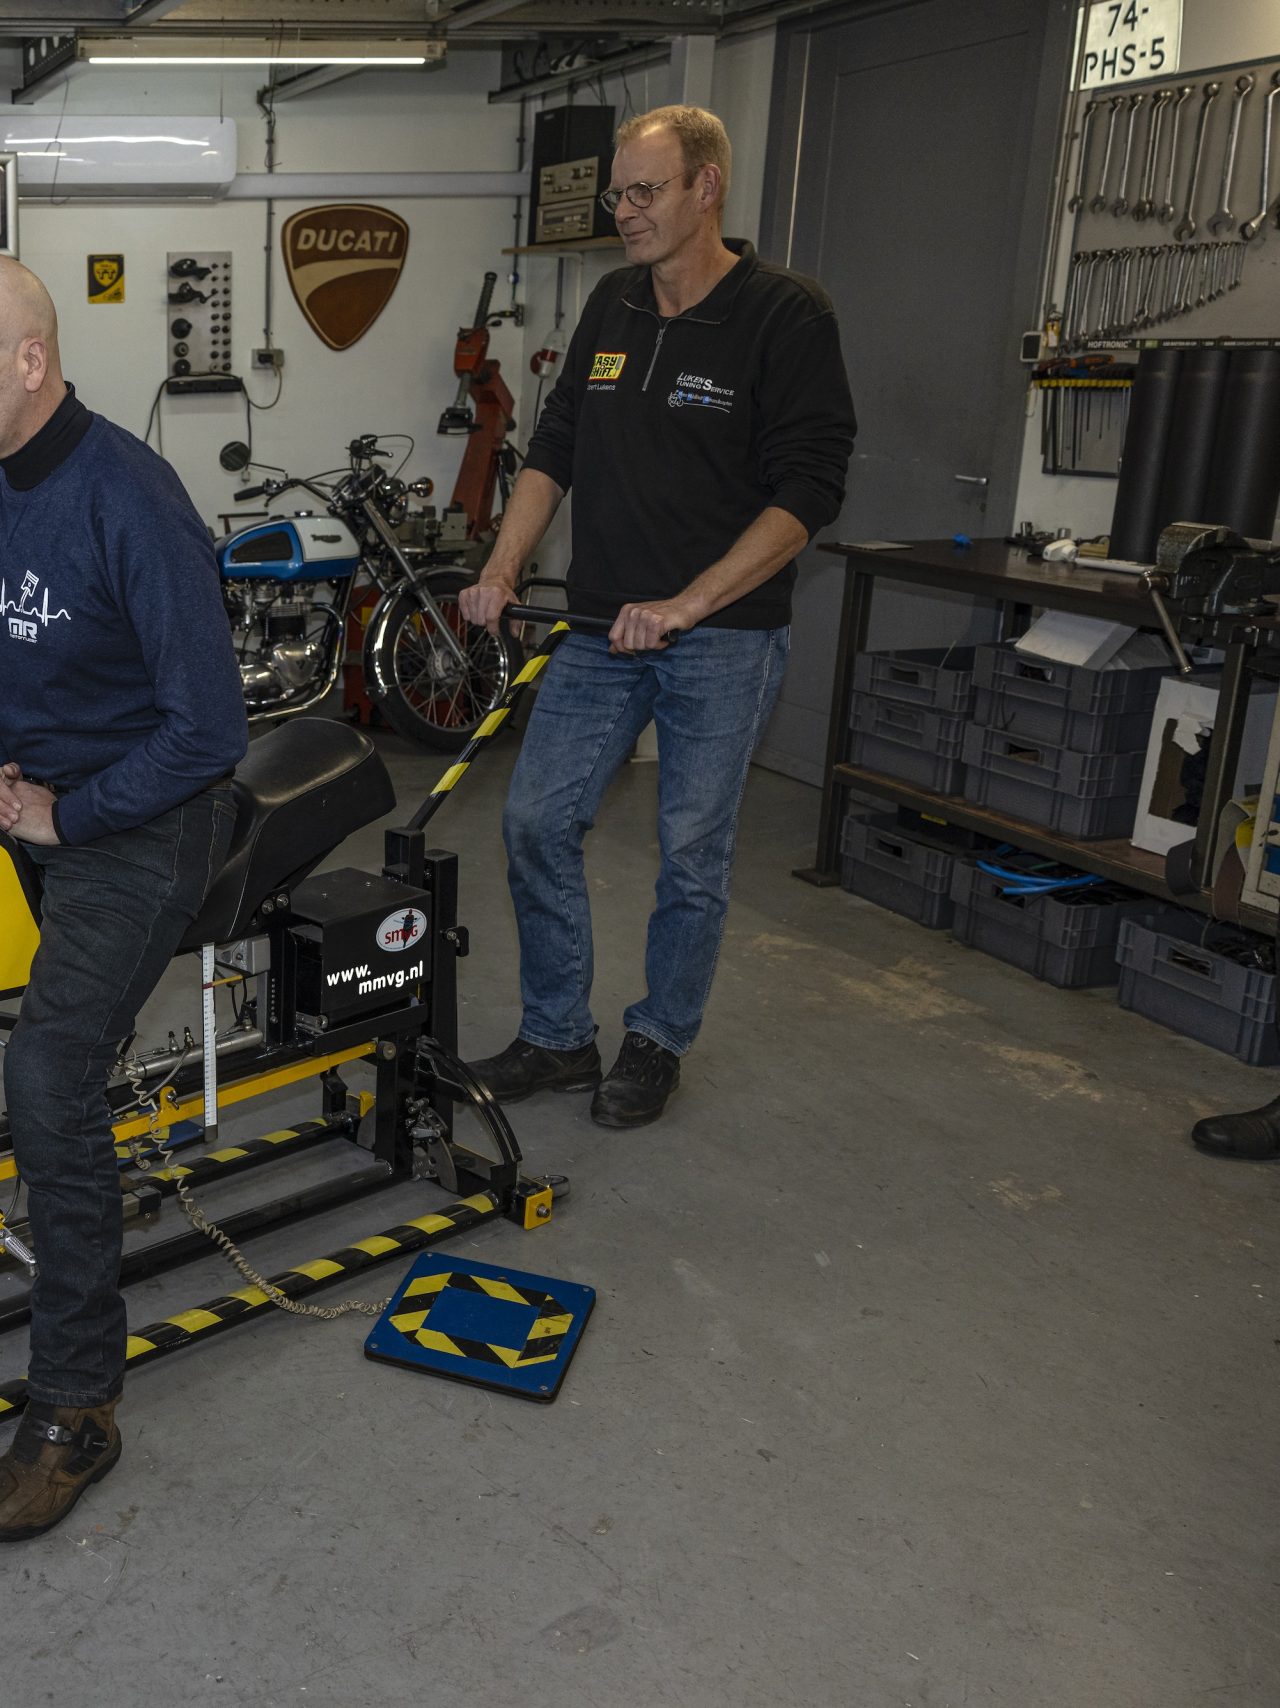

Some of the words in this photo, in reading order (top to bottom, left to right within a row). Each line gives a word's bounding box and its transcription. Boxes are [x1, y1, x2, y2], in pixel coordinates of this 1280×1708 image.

[1108, 0, 1149, 37] 74-
[1082, 36, 1165, 84] PHS-5
[297, 228, 398, 252] DUCATI
[326, 964, 371, 987] www.
[358, 960, 423, 995] mmvg.nl
